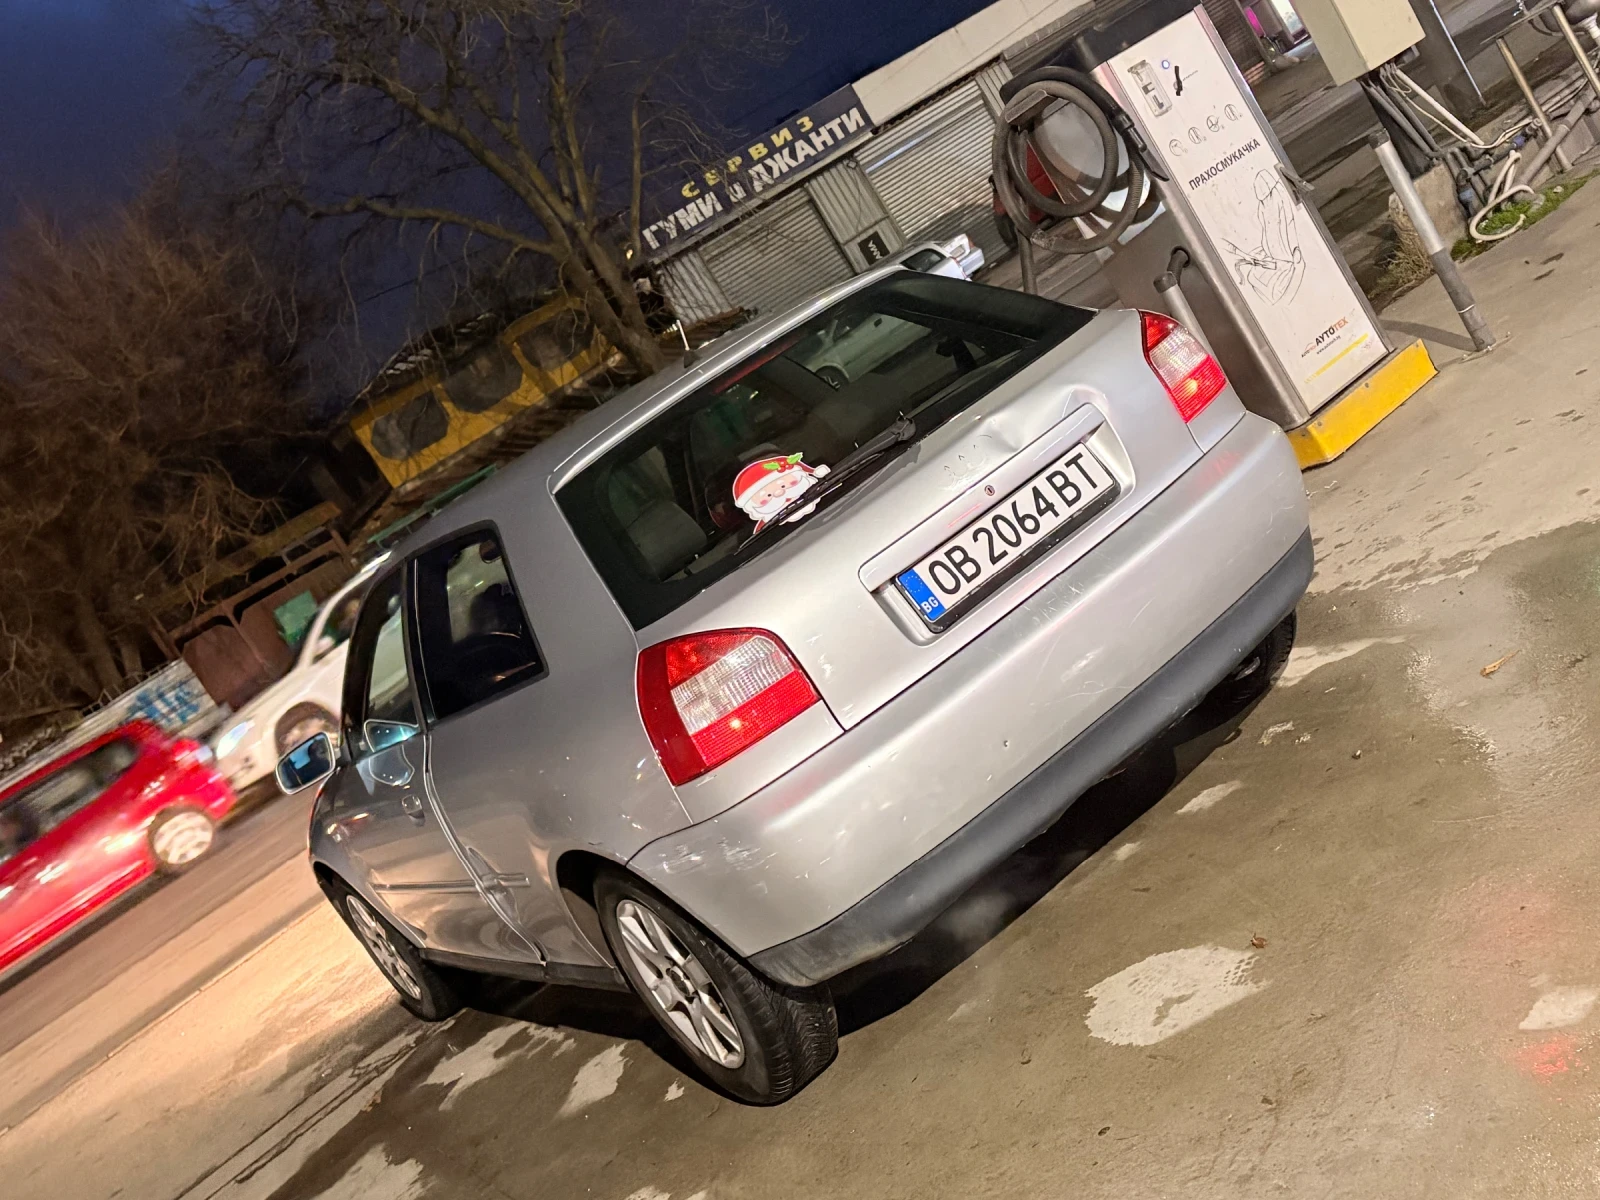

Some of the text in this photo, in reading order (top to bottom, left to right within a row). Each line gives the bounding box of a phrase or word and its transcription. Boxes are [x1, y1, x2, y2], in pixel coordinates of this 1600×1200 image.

[642, 191, 723, 250] ГУМИ
[748, 107, 866, 193] ДЖАНТИ
[681, 115, 814, 198] СЕРВИЗ
[1188, 138, 1261, 191] ПРАХОСМУКАЧКА
[928, 452, 1098, 596] OB 2064 BT
[920, 597, 939, 613] BG
